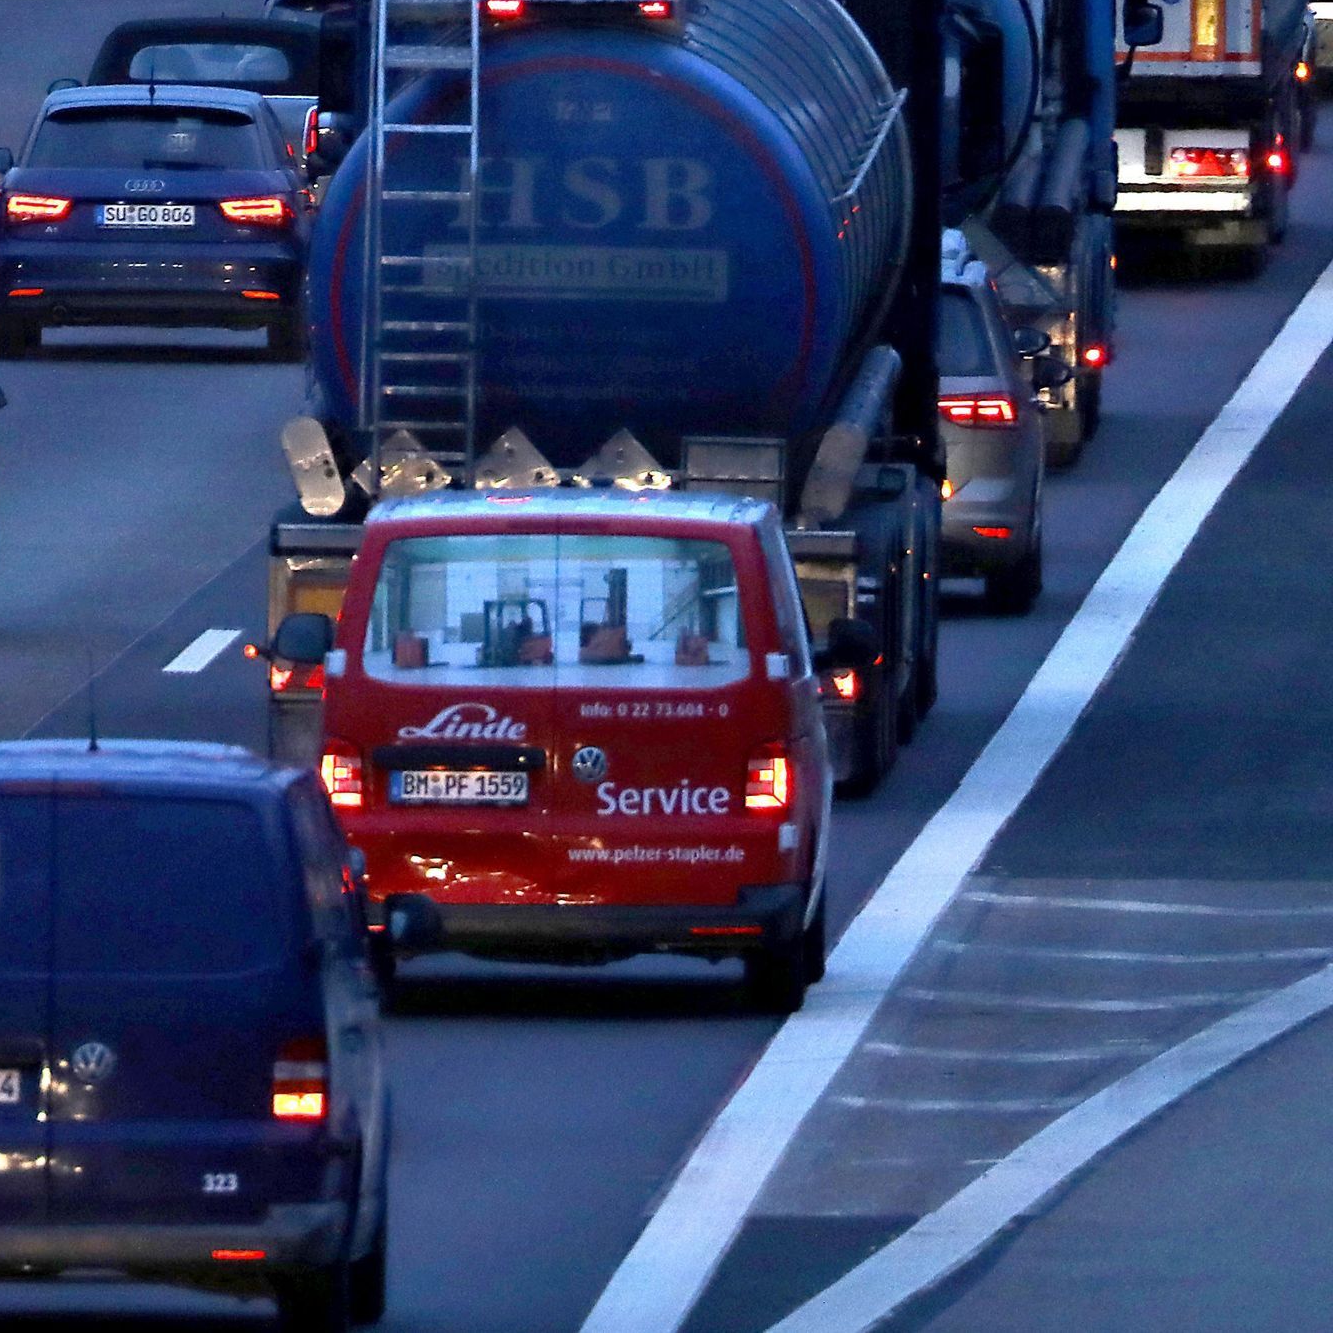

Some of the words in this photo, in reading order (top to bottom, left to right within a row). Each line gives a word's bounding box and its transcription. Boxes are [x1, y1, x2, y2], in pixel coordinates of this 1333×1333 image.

[447, 155, 717, 231] HSB
[105, 207, 128, 222] SU
[162, 207, 193, 223] 806
[397, 702, 528, 740] Linde
[403, 773, 429, 795] BM
[445, 775, 469, 795] PF
[474, 775, 526, 797] 1559
[596, 778, 731, 816] Service
[568, 844, 746, 865] www.pelzer-stapler.de
[201, 1173, 239, 1193] 323
